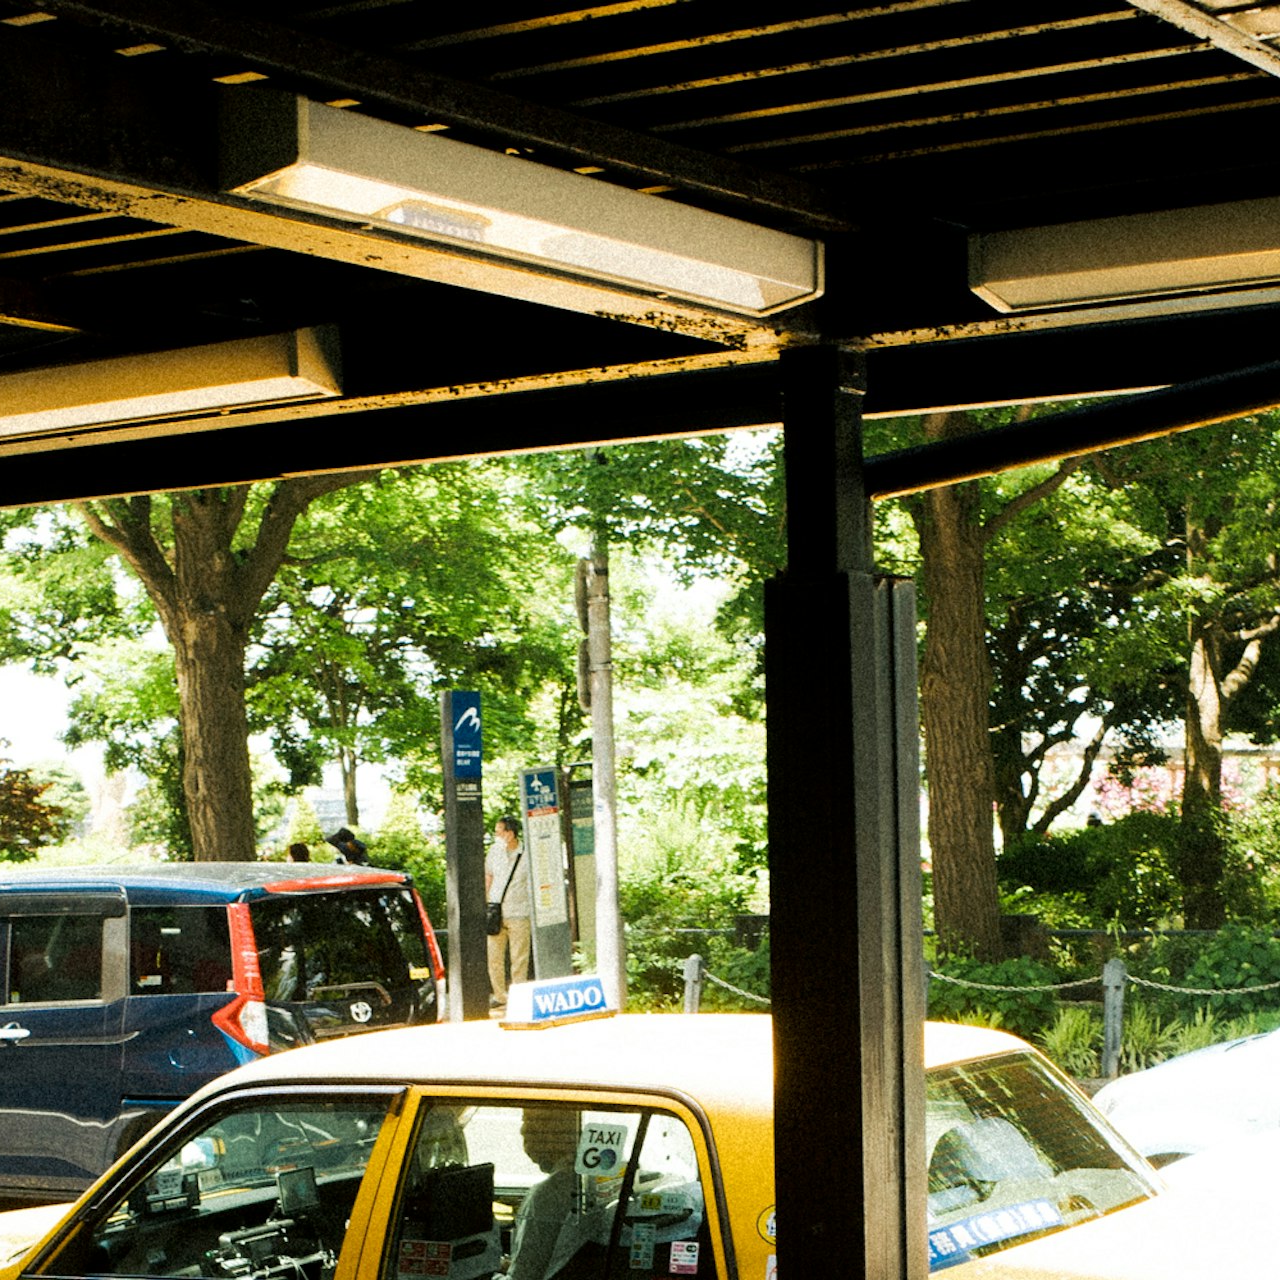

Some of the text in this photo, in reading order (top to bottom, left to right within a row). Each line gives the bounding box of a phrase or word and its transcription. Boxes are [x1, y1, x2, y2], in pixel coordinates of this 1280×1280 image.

[534, 986, 602, 1014] WADO
[588, 1129, 622, 1145] TAXI
[582, 1146, 617, 1170] GO
